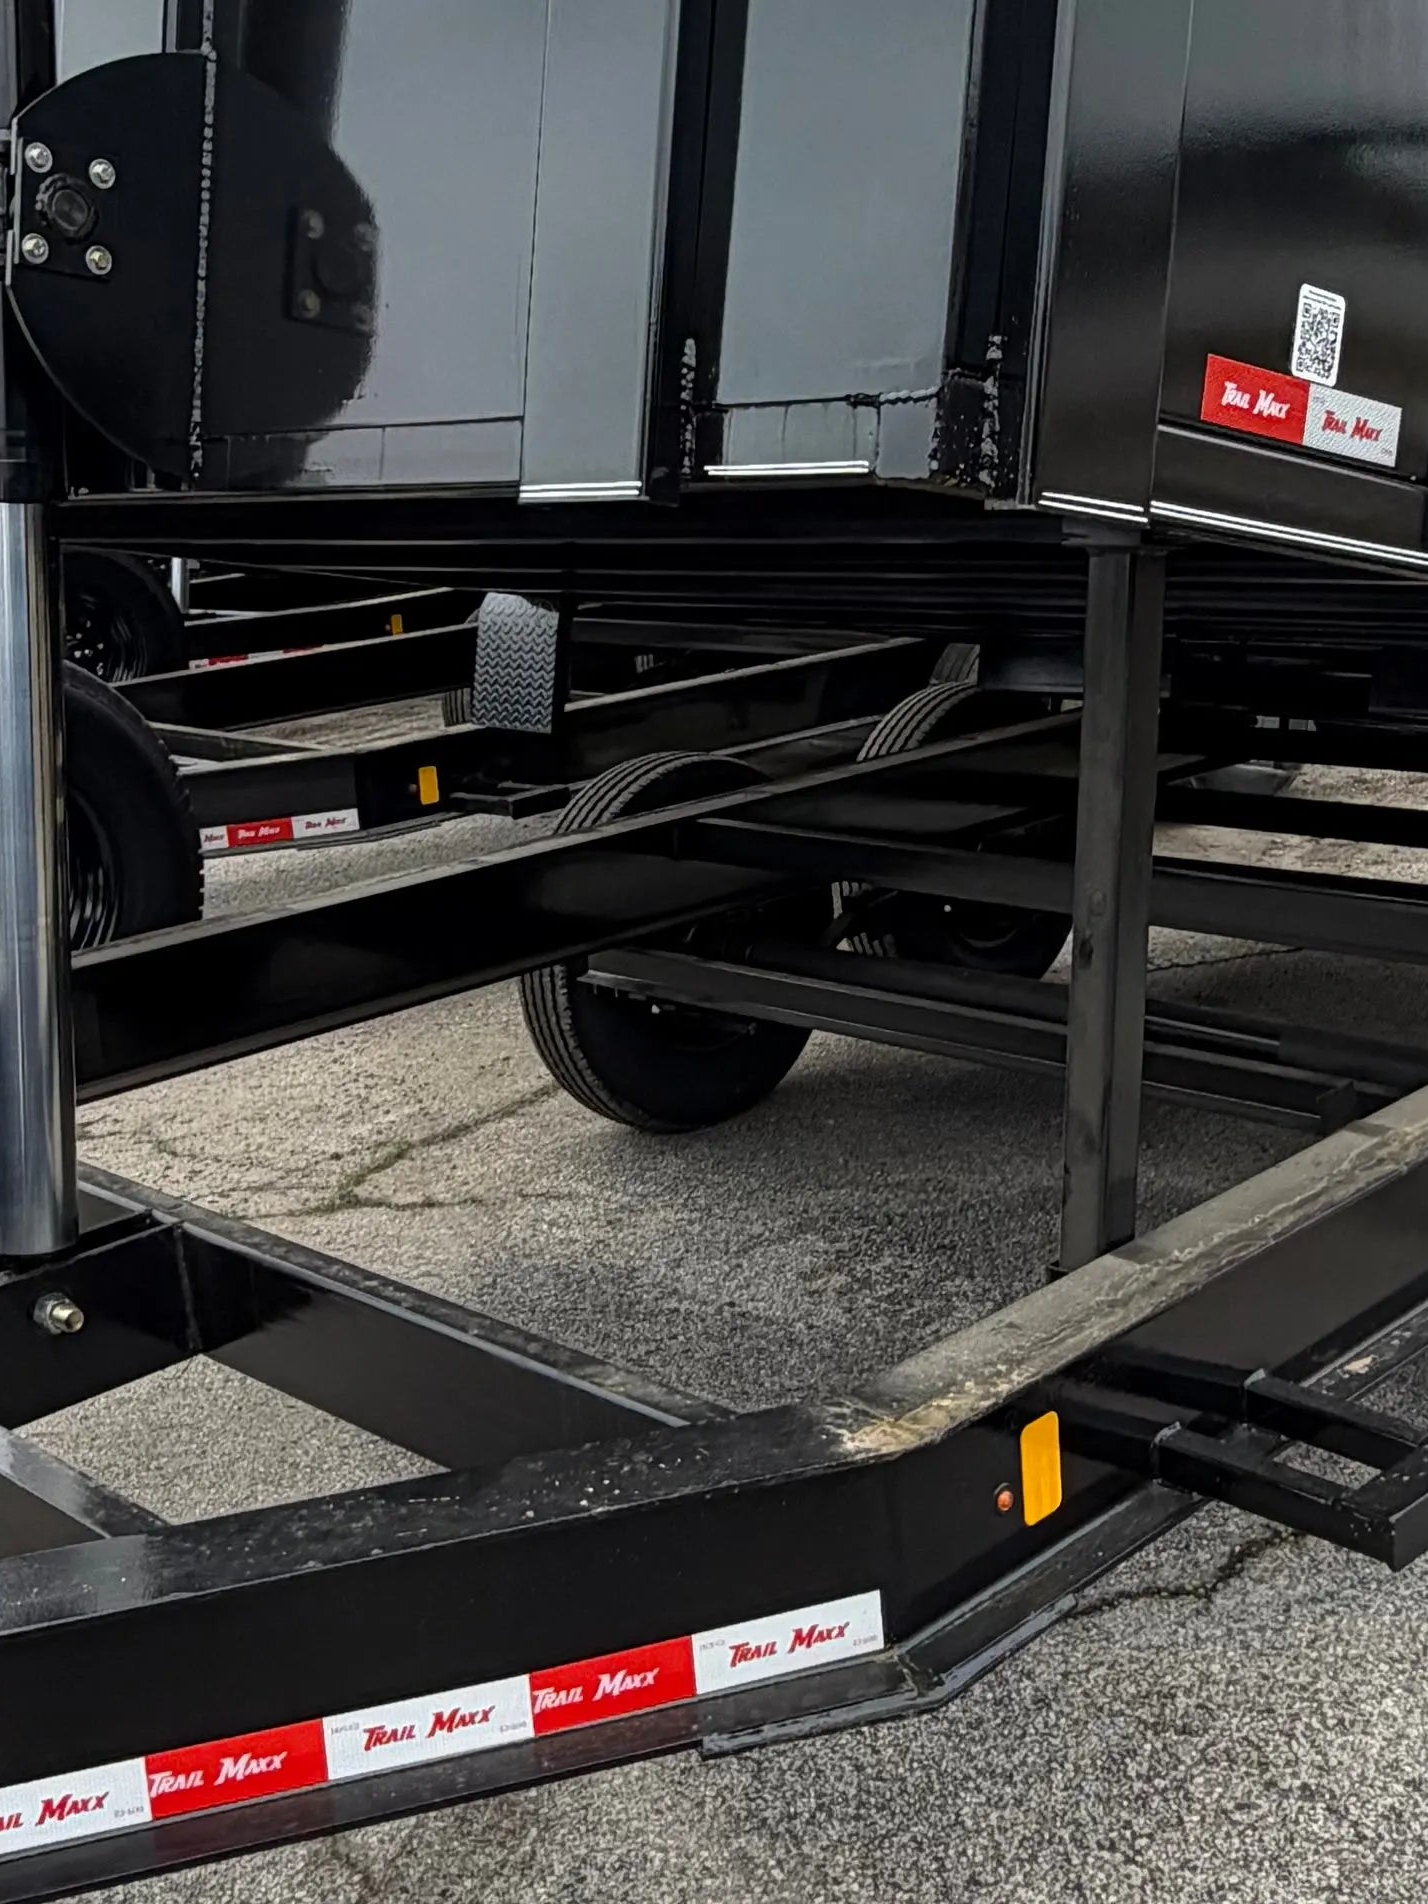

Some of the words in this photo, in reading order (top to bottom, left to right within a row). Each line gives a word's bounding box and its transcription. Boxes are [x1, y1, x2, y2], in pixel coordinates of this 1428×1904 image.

[728, 1641, 778, 1668] TRAIL
[787, 1621, 851, 1654] MAXX
[532, 1685, 584, 1714] TRAIL
[592, 1667, 660, 1701] MAXX
[363, 1724, 417, 1751] TRAIL
[425, 1705, 496, 1738] MAXX
[148, 1765, 205, 1797] TRAIL
[214, 1750, 289, 1789] MAXX
[34, 1791, 110, 1827] MAXX
